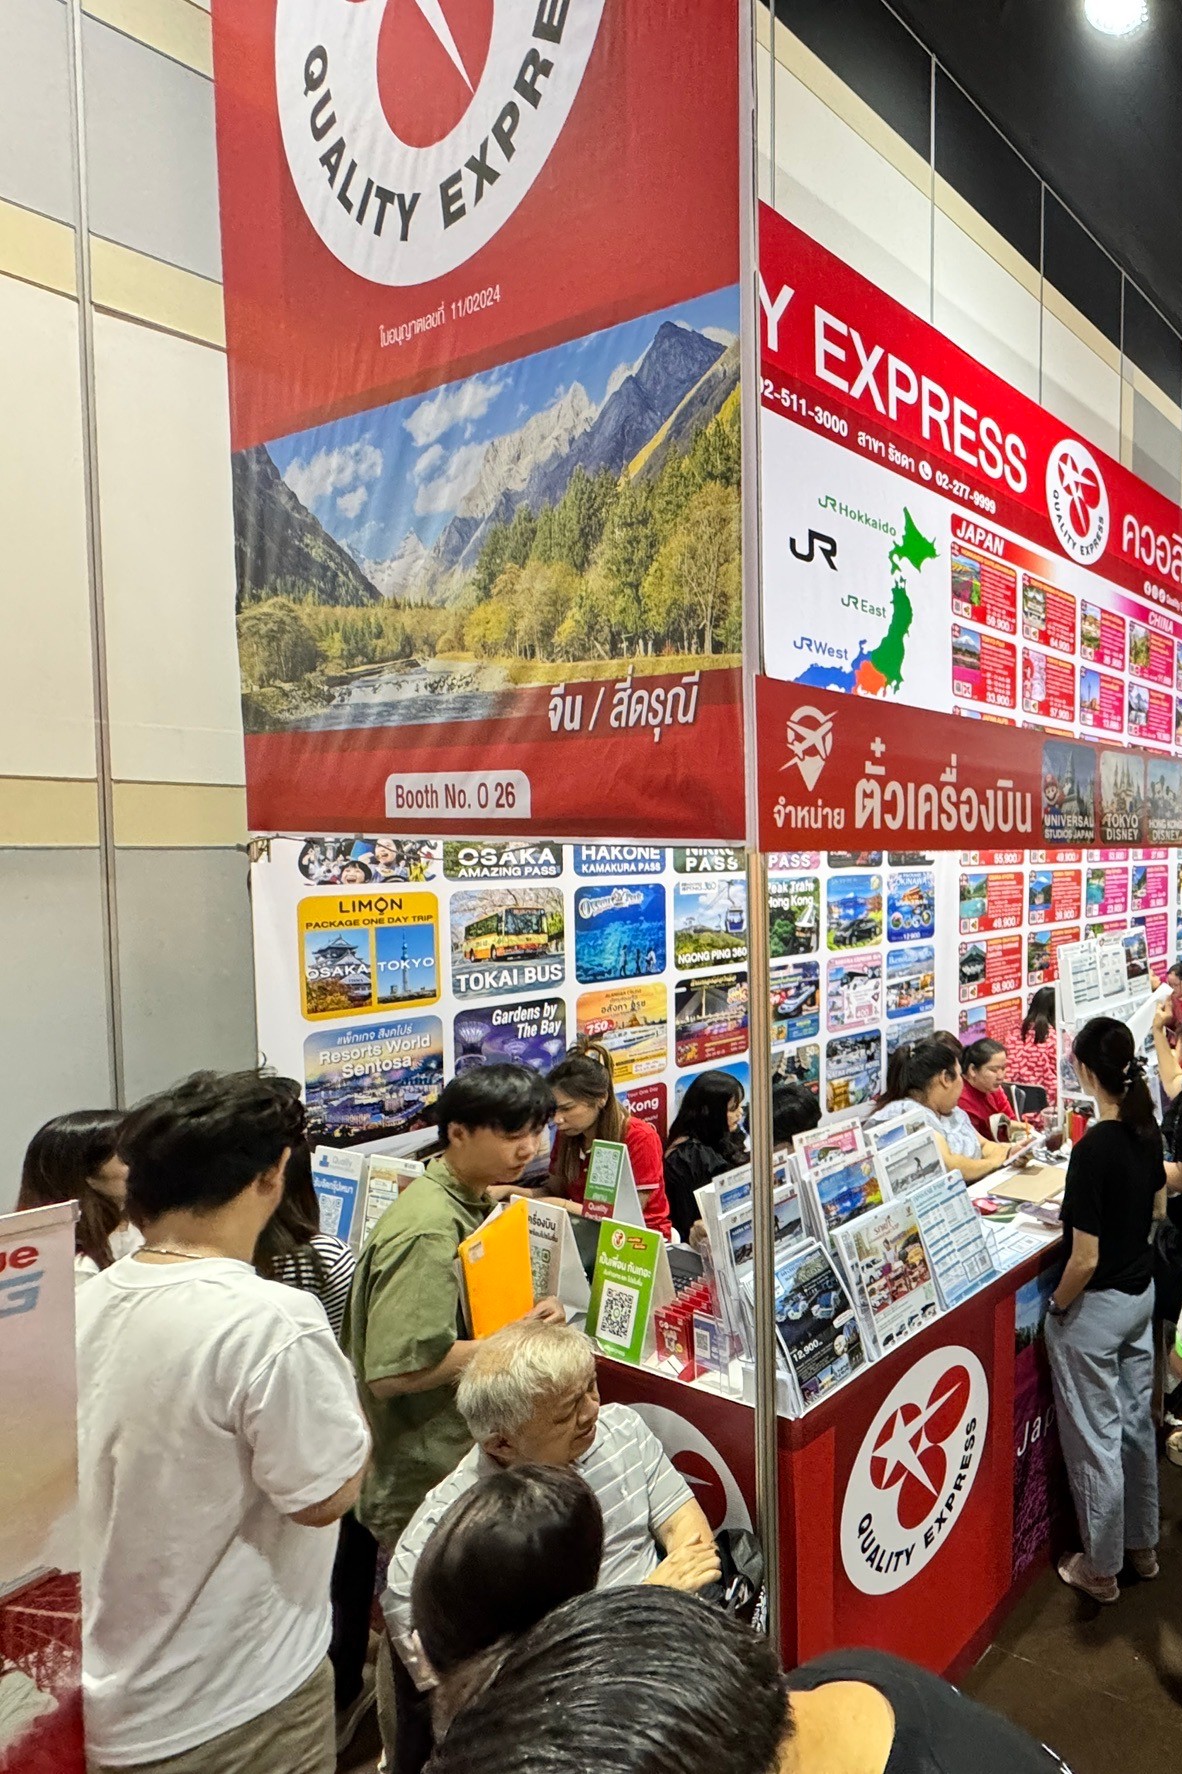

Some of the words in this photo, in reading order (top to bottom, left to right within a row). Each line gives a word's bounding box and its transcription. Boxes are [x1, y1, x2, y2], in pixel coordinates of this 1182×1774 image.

[303, 44, 422, 243] QUALITY
[451, 284, 501, 320] 11/02024
[813, 303, 1028, 495] EXPRESS
[935, 470, 997, 515] 02-277-9999
[818, 495, 837, 512] JR
[839, 502, 897, 537] Hokkaido
[1053, 489, 1077, 550] QUALITY
[956, 520, 1005, 557] JAPAN
[789, 528, 838, 572] JR
[841, 594, 858, 610] JR
[861, 599, 886, 618] East
[1148, 611, 1174, 634] CHINA
[793, 636, 813, 652] JR
[813, 640, 849, 661] West
[547, 683, 583, 733] จีน
[773, 796, 845, 830] จำหน่าย
[854, 736, 1032, 833] ตั๋วเครื่องบิน
[395, 783, 439, 810] Booth
[445, 783, 472, 810] No.
[494, 782, 516, 809] 26
[1044, 814, 1095, 828] UNIVERSAL
[1107, 814, 1139, 828] TOKYO
[1044, 829, 1072, 839] STUDIOS
[1073, 829, 1094, 840] JAPAN
[1106, 828, 1139, 841] DISNEY
[1152, 830, 1180, 841] DISNEY
[457, 847, 557, 866] OSAKA
[581, 845, 661, 861] HAKONE
[768, 854, 811, 868] PASS
[458, 866, 522, 878] AMAZING
[524, 865, 557, 876] PASS
[581, 863, 636, 874] KAMAKURA
[637, 862, 661, 872] PASS
[686, 856, 739, 872] PASS
[791, 895, 814, 907] Kong
[305, 919, 360, 930] PACKAGE
[362, 917, 385, 926] ONE
[387, 916, 409, 924] DAY
[411, 914, 434, 923] TRIP
[378, 957, 435, 972] TOKYO
[678, 950, 711, 965] NGONG
[711, 947, 731, 961] PING
[306, 964, 370, 980] OSAKA
[455, 968, 518, 992] TOKAI
[524, 964, 563, 984] BUS
[492, 1005, 540, 1026] Gardens
[543, 1002, 558, 1020] by
[517, 1022, 538, 1039] The
[540, 1020, 562, 1037] Bay
[319, 1043, 381, 1065] Resorts
[385, 1034, 431, 1054] World
[341, 1055, 412, 1079] Sentosa
[628, 1097, 660, 1113] Kong
[588, 1202, 609, 1214] Quality
[857, 1512, 916, 1573] QUALITY
[924, 1417, 977, 1549] EXPRESS
